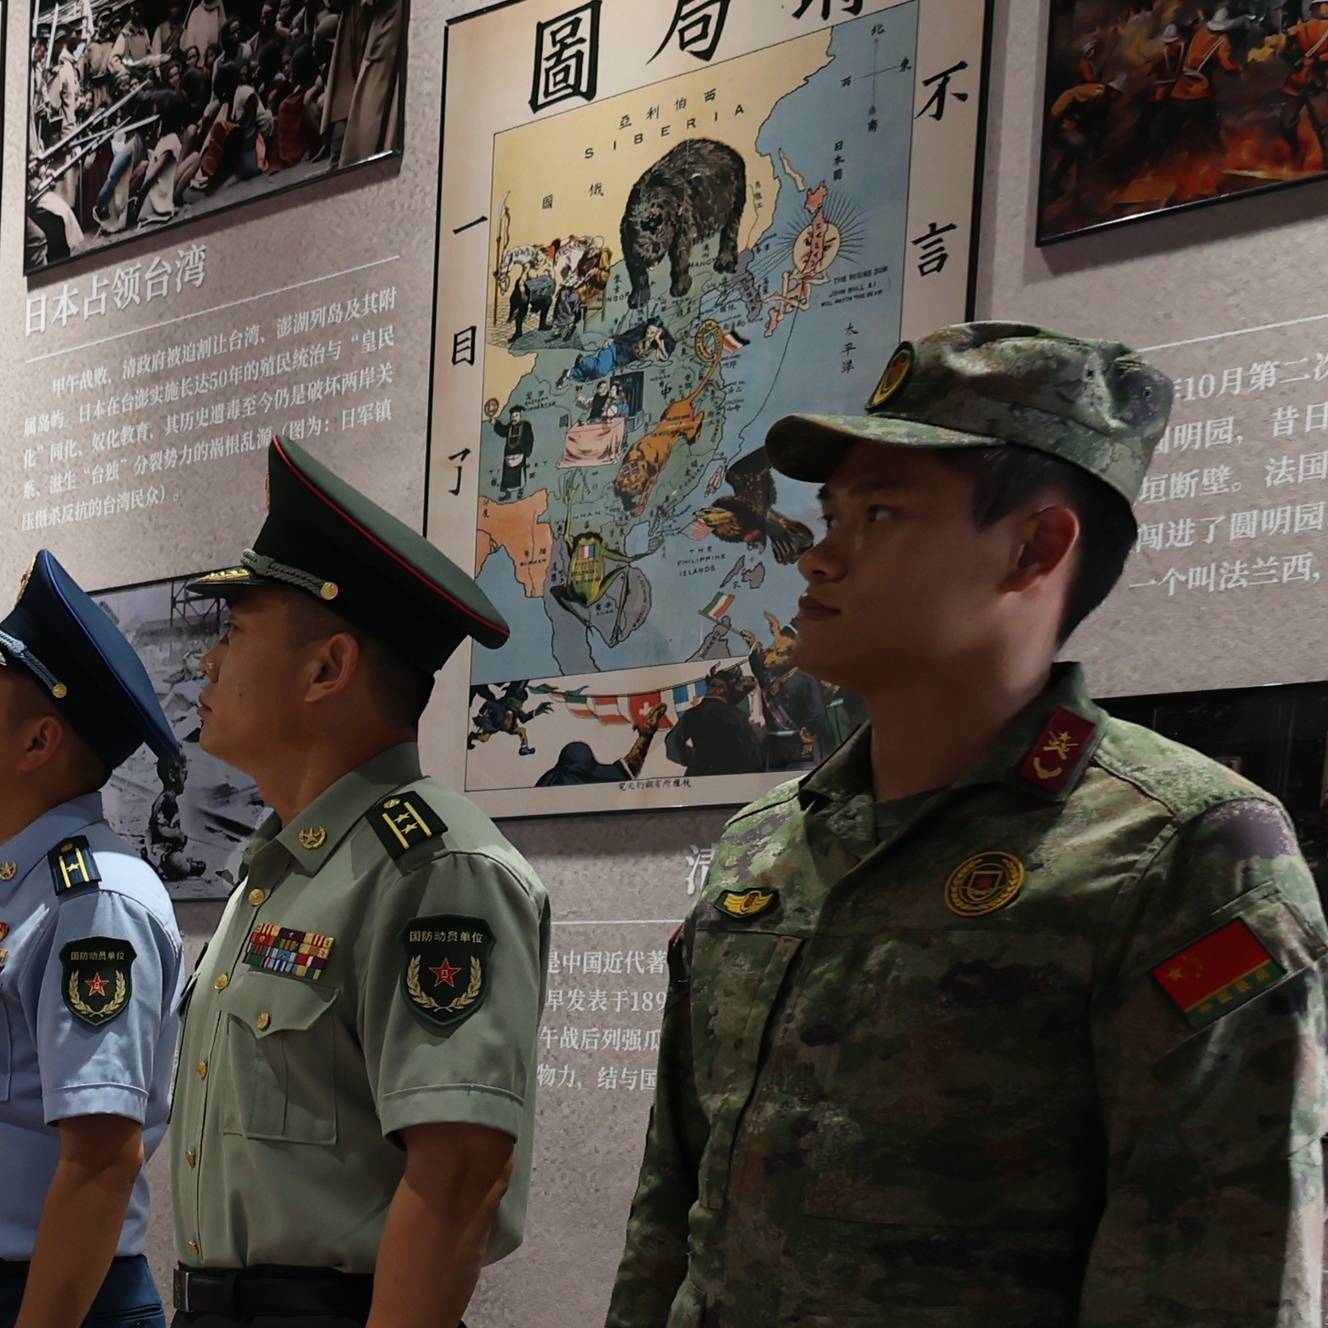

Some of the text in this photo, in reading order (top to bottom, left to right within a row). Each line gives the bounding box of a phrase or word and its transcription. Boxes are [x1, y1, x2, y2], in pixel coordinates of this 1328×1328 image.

[584, 104, 746, 160] SIBERIA
[24, 243, 208, 338] 日本占领台湾
[1129, 552, 1320, 597] 一个叫法兰西，
[409, 930, 483, 943] 国防动员单位
